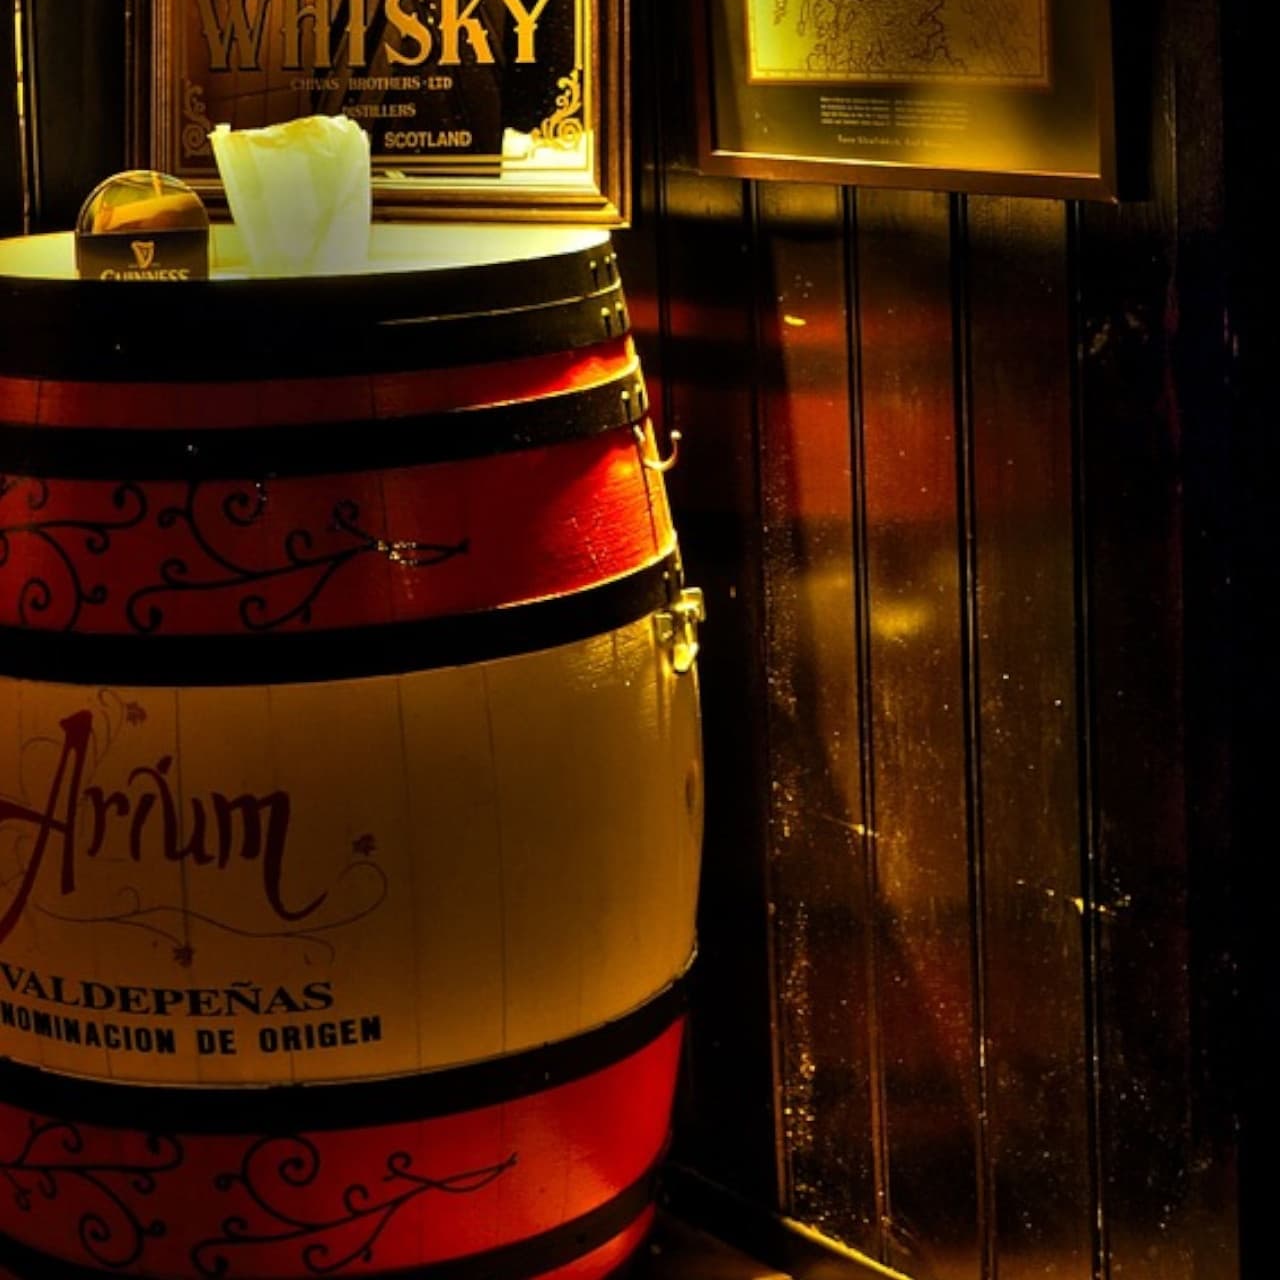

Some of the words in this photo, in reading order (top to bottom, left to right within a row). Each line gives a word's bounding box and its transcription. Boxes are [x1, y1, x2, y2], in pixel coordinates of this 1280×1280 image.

[384, 129, 473, 150] SCOTLAND
[0, 961, 334, 1017] VALDEPEÑAS
[196, 1028, 237, 1056] DE
[259, 1015, 383, 1052] ORIGEN
